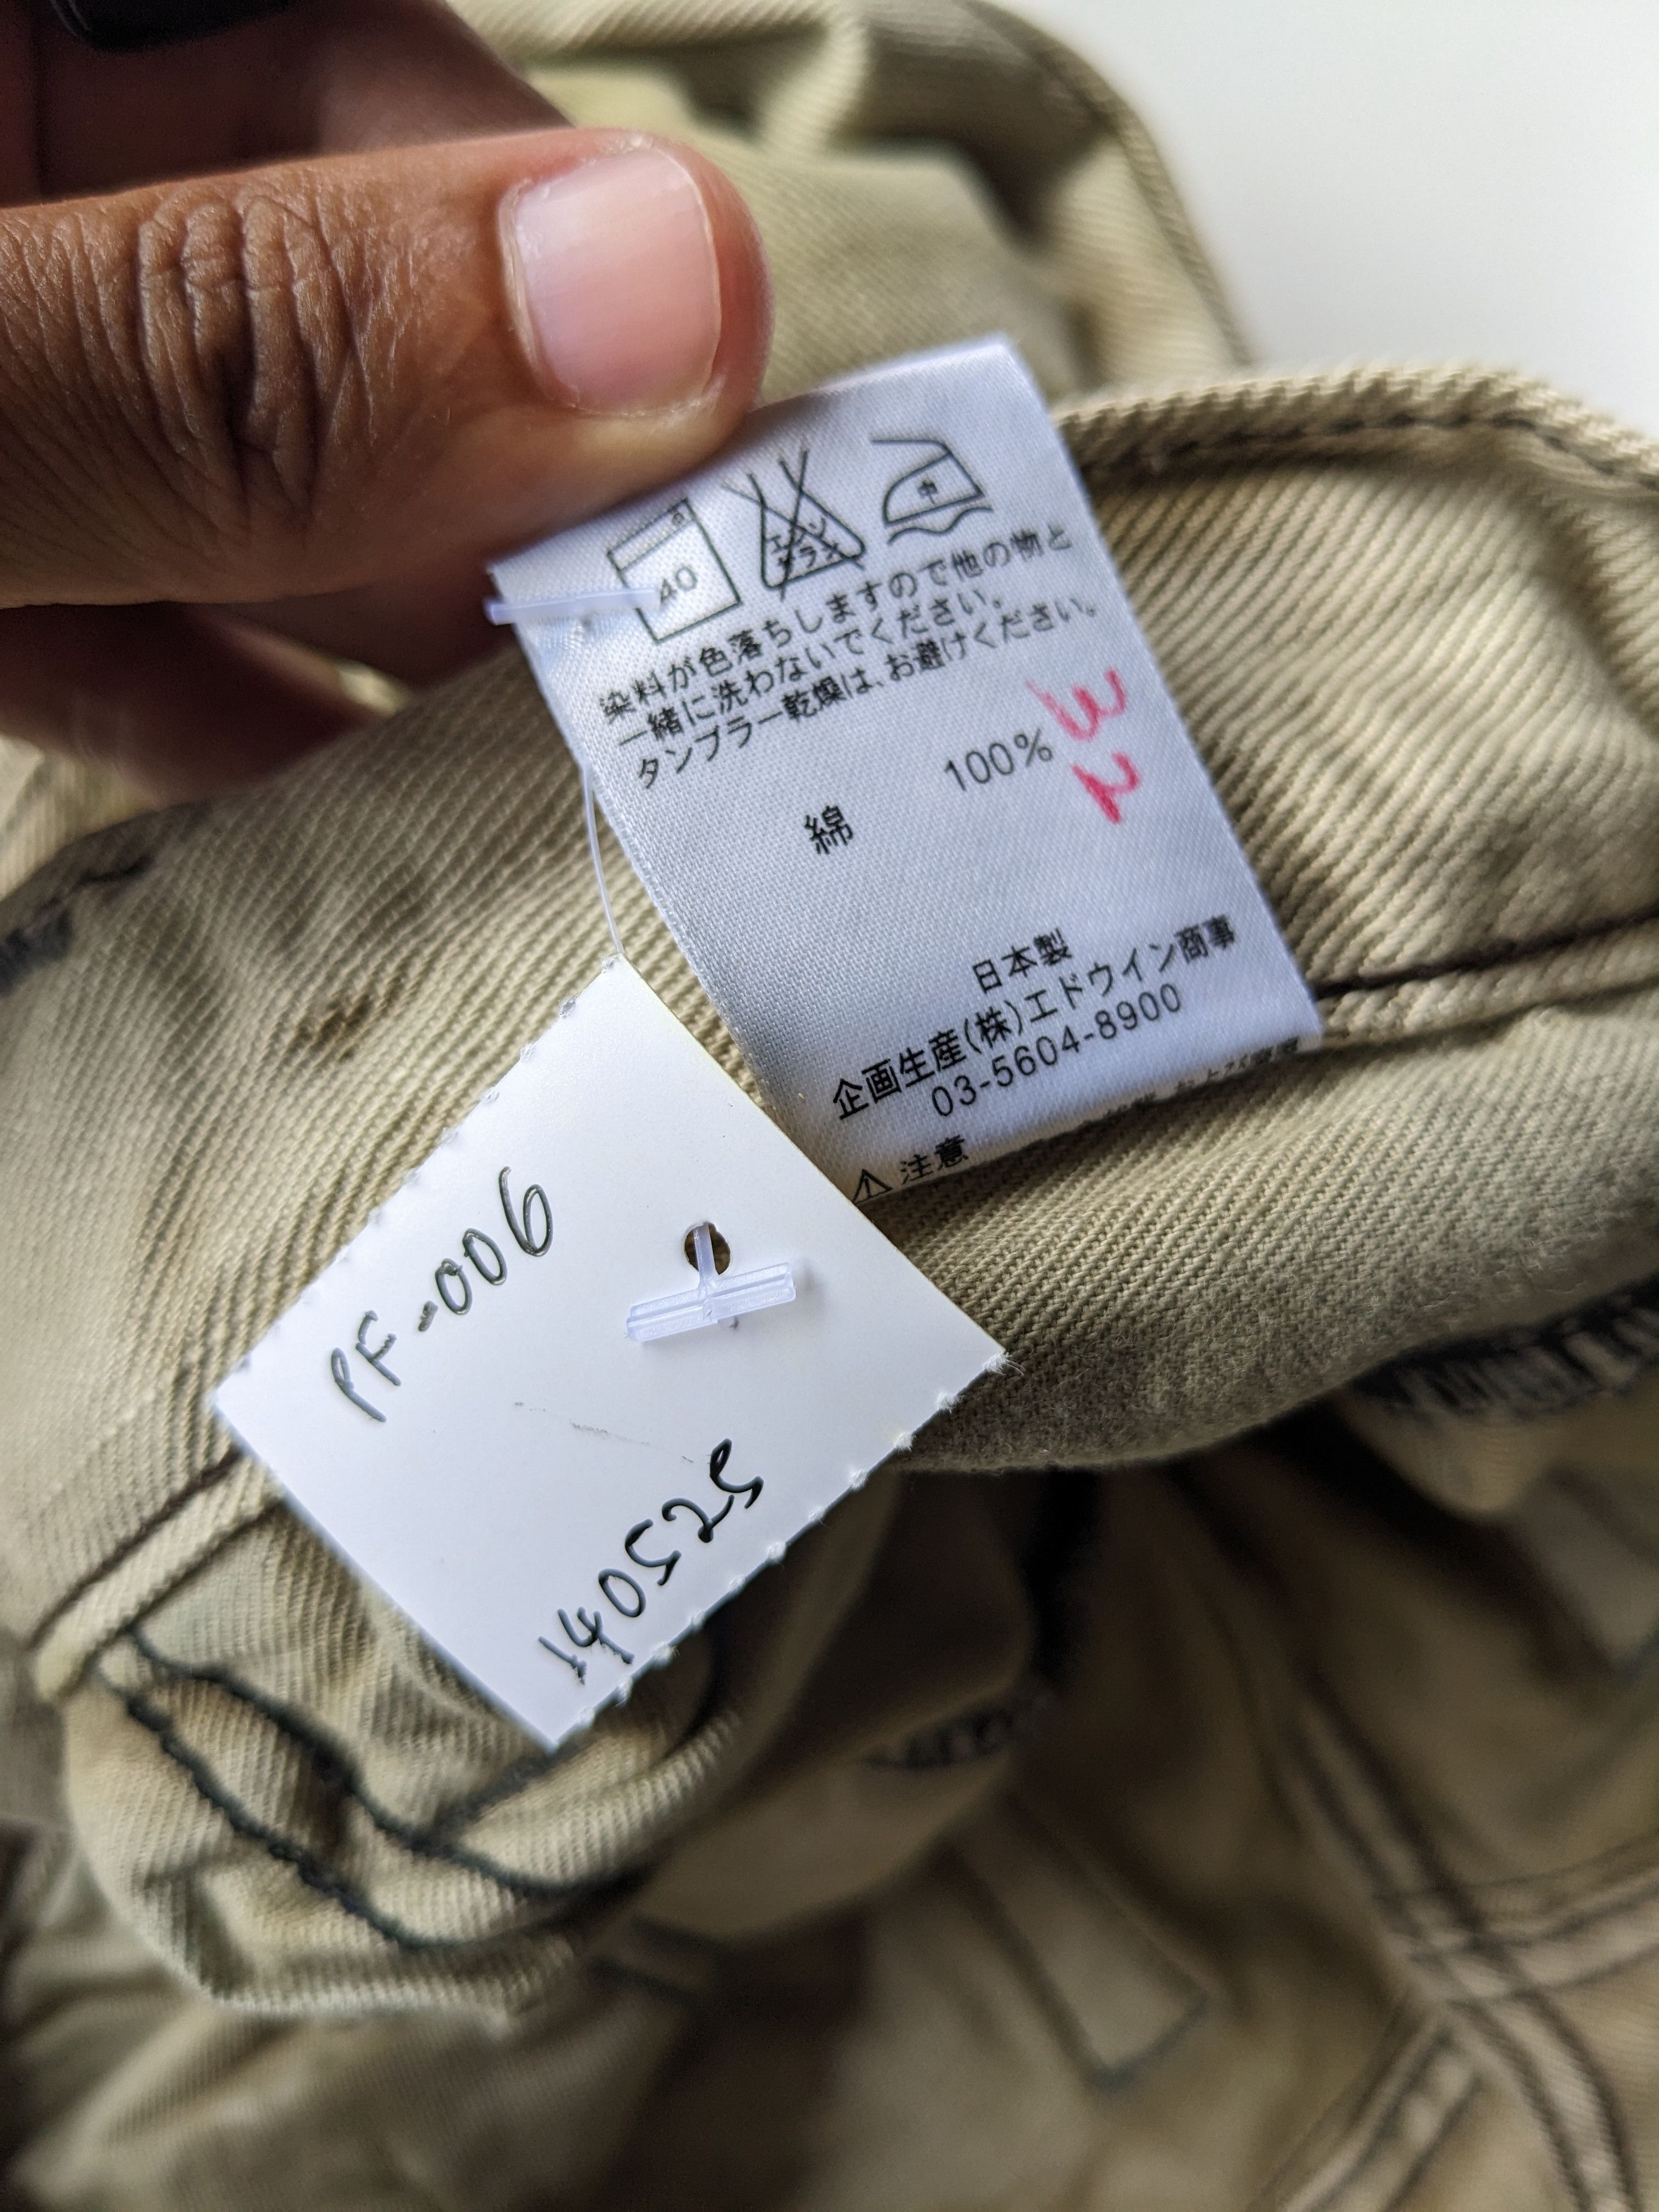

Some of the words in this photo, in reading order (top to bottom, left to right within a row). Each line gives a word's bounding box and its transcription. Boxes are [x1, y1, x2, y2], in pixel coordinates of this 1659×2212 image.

[599, 525, 1073, 722] 染料が色落ちしますので他の物と
[659, 566, 698, 605] 40
[618, 593, 1002, 746] 一緒に洗わないでください。
[944, 727, 1052, 791] 100%
[803, 805, 854, 854] 綿
[972, 927, 1074, 994] 日本製
[832, 915, 1236, 1120] 企画生産(株)エドウイン商事
[932, 983, 1182, 1117] 03-5604-8900
[899, 1134, 969, 1186] 注意
[331, 1167, 554, 1422] PF-006
